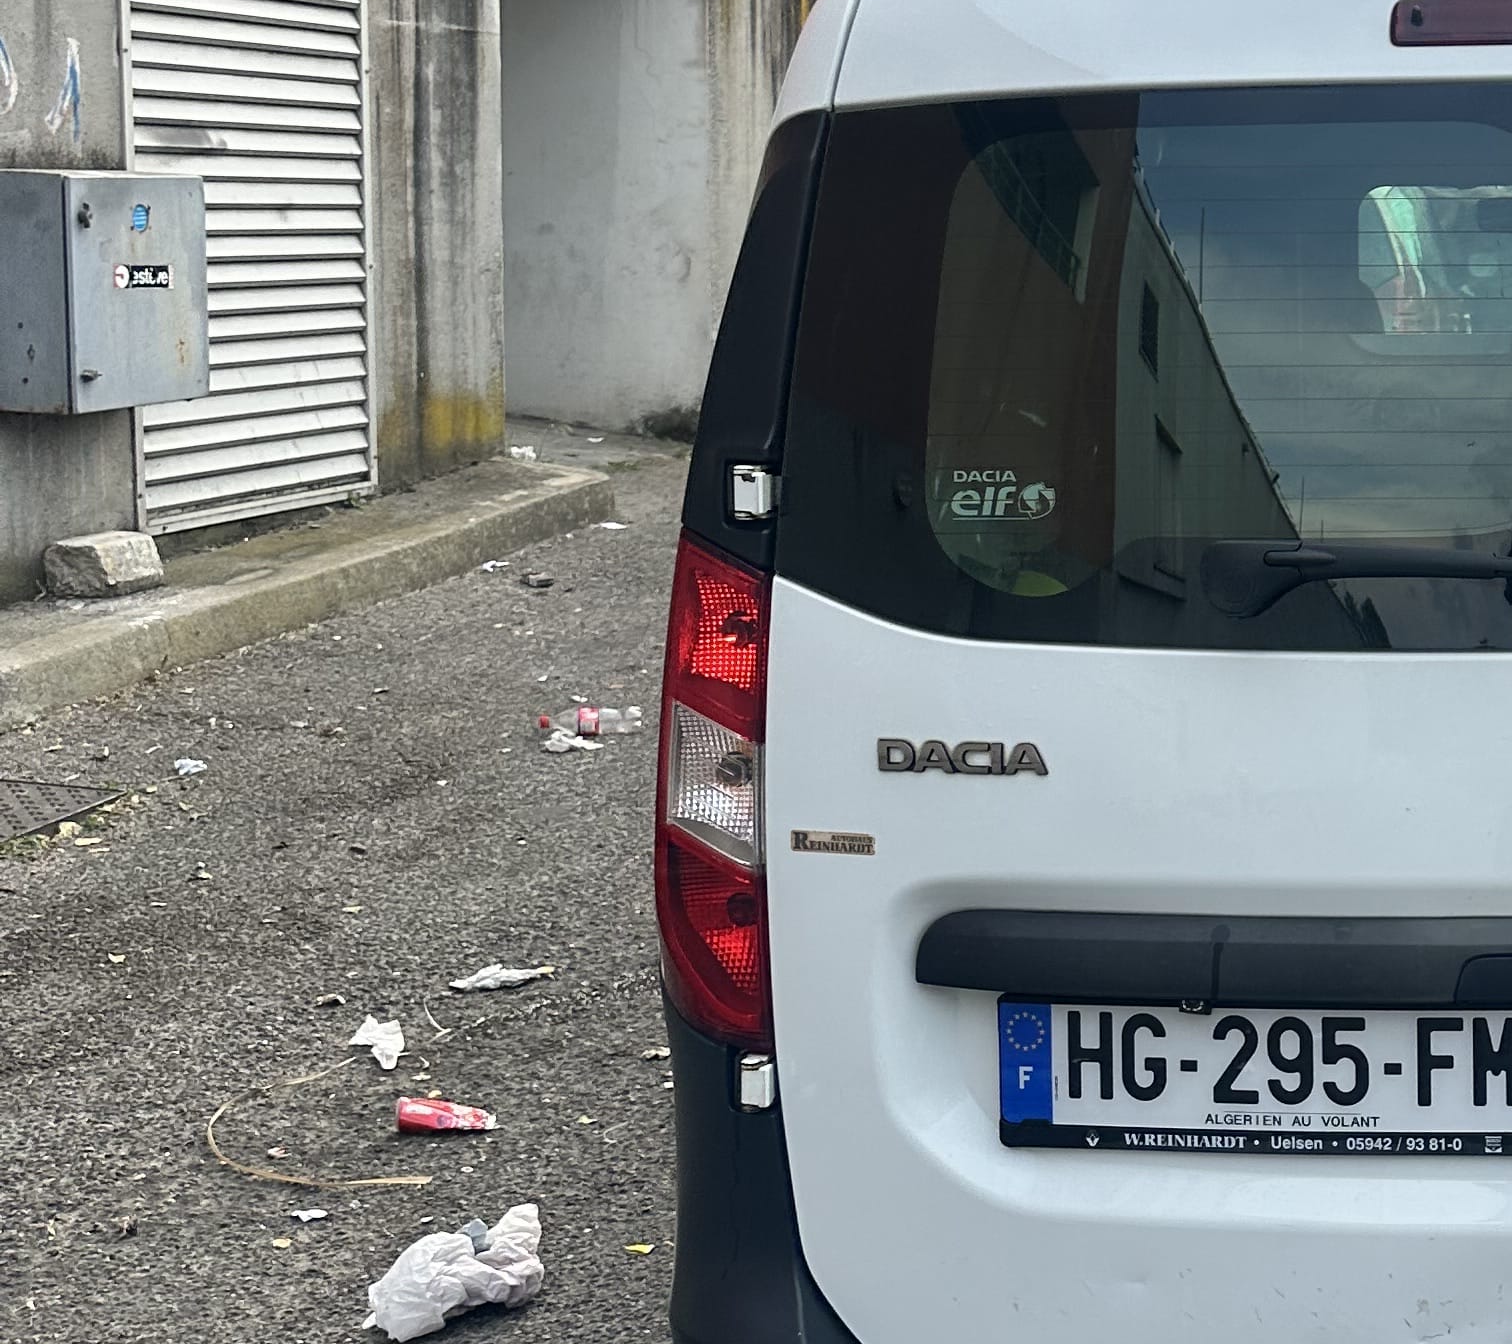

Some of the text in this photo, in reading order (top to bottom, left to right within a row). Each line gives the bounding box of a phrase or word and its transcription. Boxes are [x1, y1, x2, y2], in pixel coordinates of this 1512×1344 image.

[953, 470, 1017, 483] DACIA
[951, 486, 1017, 516] elf
[877, 737, 1049, 776] DACIA
[1018, 1065, 1034, 1090] F
[1205, 1113, 1380, 1128] ALGERIEN AU VOLANT
[1271, 1136, 1323, 1150] Uelsen
[1346, 1137, 1393, 1151] 05942
[1406, 1138, 1425, 1151] 93
[1429, 1138, 1462, 1151] 81-0
